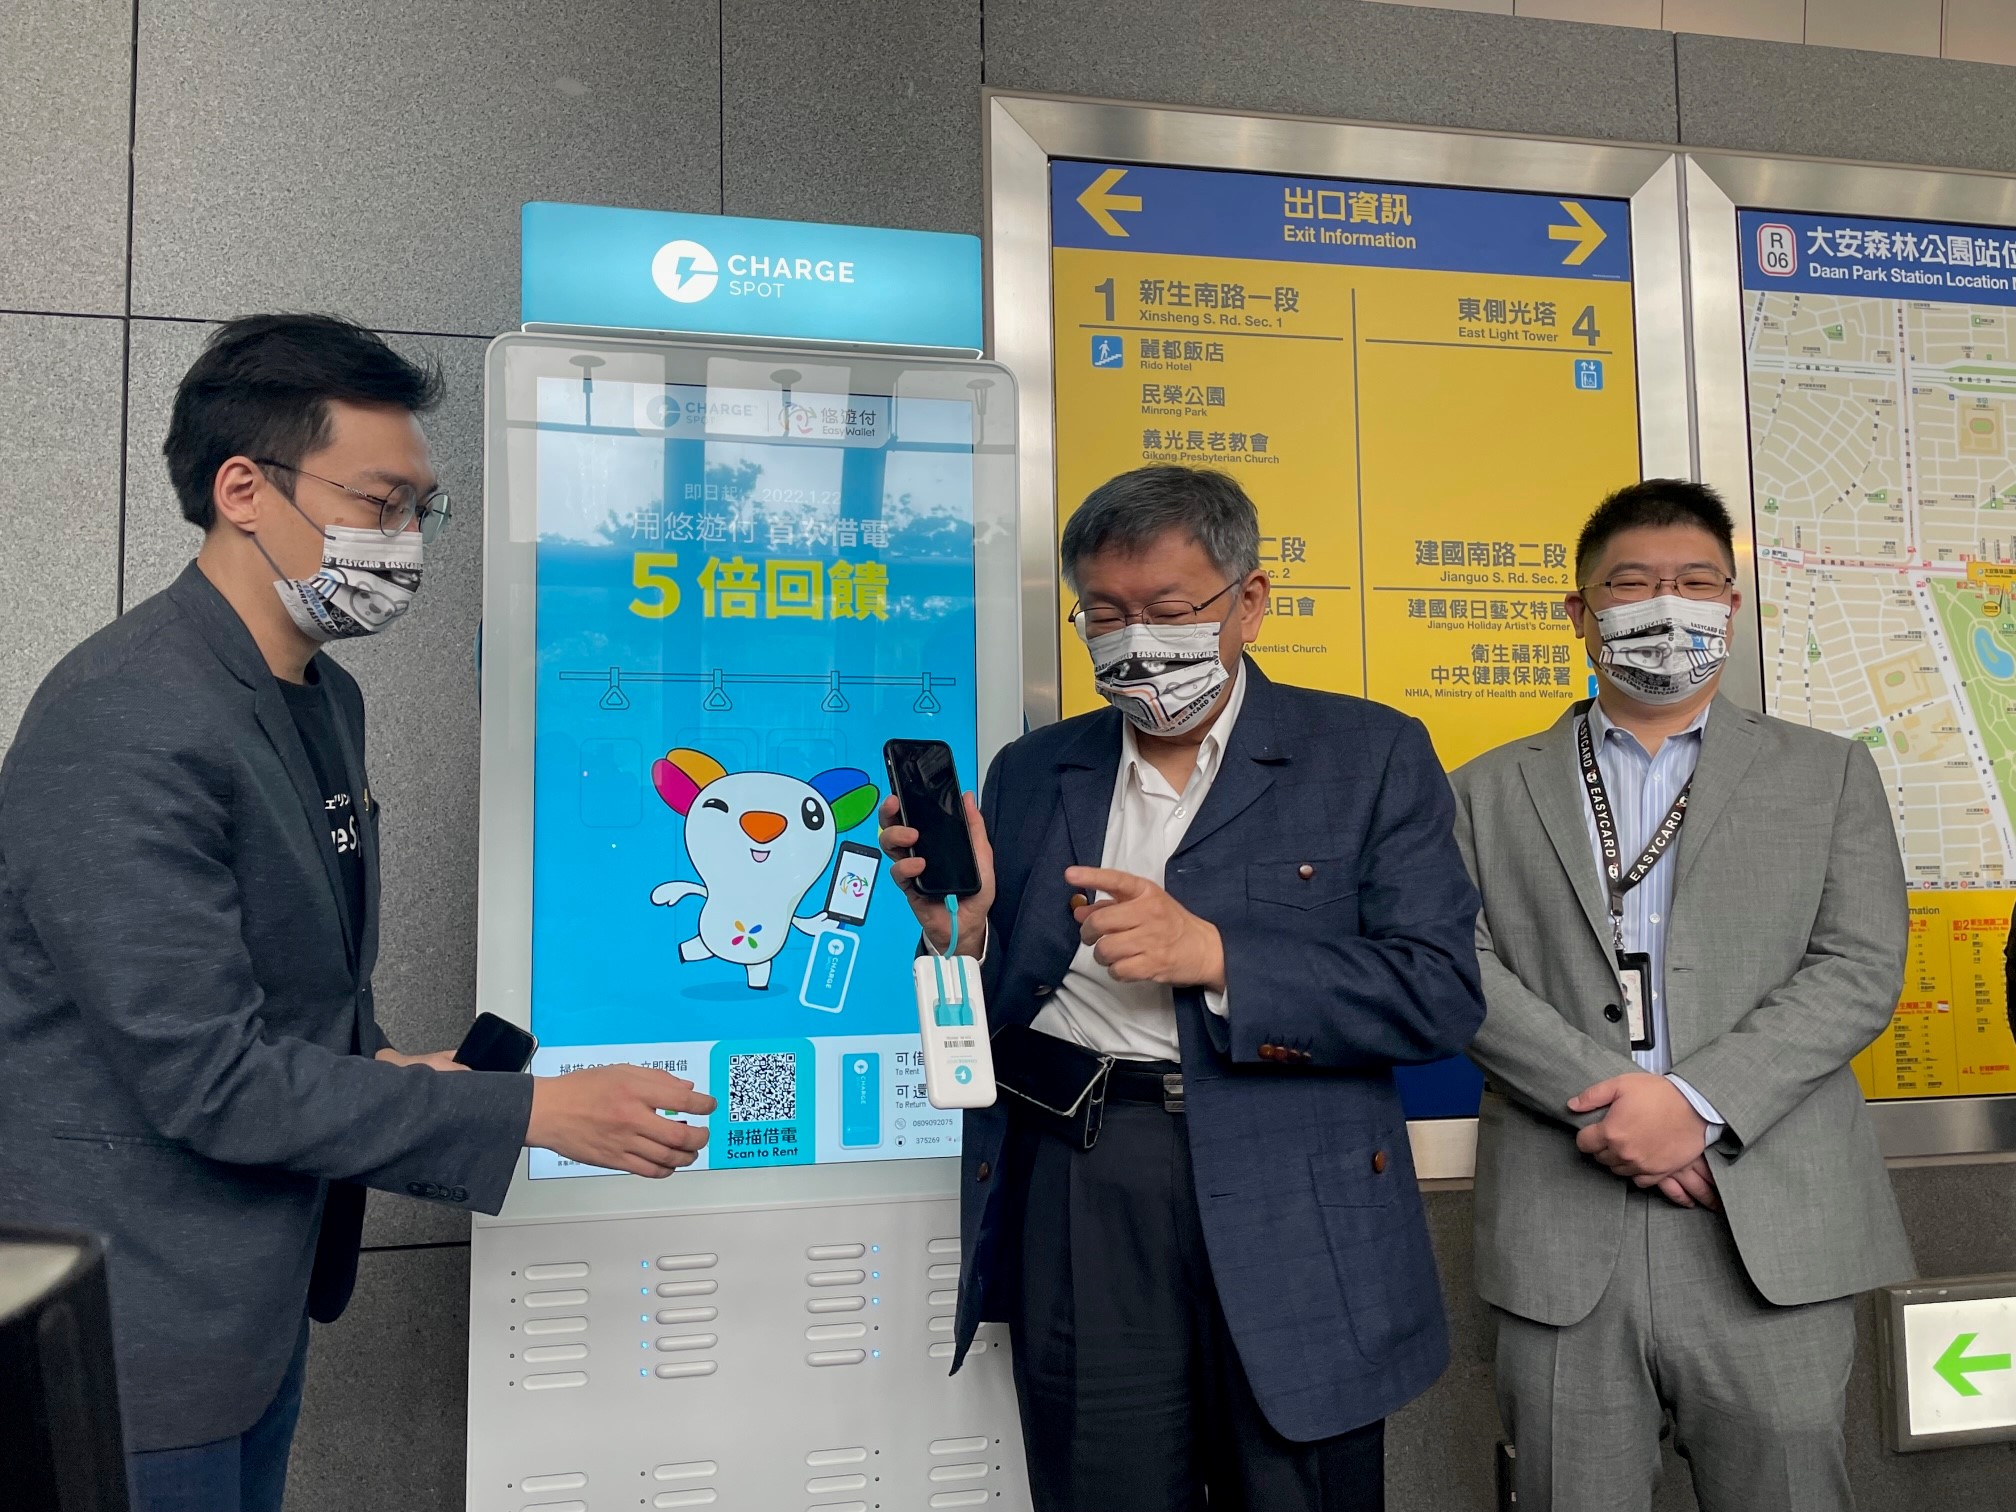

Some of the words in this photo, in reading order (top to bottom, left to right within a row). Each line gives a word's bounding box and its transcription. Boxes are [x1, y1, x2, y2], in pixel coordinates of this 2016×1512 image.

[1284, 186, 1412, 226] 出口資訊
[1283, 224, 1316, 243] Exit
[1320, 227, 1417, 250] Information
[1770, 232, 1784, 249] R
[727, 254, 856, 283] CHARGE
[1767, 251, 1789, 269] 06
[1809, 262, 1849, 280] Daan
[1852, 265, 1888, 282] Park
[1890, 268, 1943, 286] Station
[1946, 271, 2009, 290] Location
[729, 280, 785, 298] SPOT
[1139, 278, 1299, 313] 新生南路一段
[1094, 278, 1115, 322] 1
[1139, 309, 1200, 326] Xinsheng
[1203, 312, 1216, 325] S.
[1220, 313, 1241, 327] Rd.
[1245, 315, 1272, 328] Sec.
[1276, 316, 1283, 328] 1
[1458, 297, 1557, 328] 東側光塔
[1458, 327, 1486, 339] East
[1489, 328, 1519, 342] Light
[1522, 330, 1559, 343] Tower
[1571, 305, 1601, 346] 4
[1140, 338, 1225, 362] 麗都飯店
[1140, 360, 1164, 371] Rido
[1166, 361, 1193, 371] Hotel
[1141, 383, 1226, 407] 民榮公園
[685, 401, 752, 417] CHARGE
[821, 407, 877, 426] 悠遊付
[1141, 405, 1182, 417] Minrong
[1184, 407, 1208, 417] Park
[822, 425, 876, 437] EasyWallet
[1142, 428, 1269, 453] 義光長老教會
[1142, 450, 1178, 463] Gikong
[1180, 451, 1242, 464] Presbyterian
[1244, 454, 1280, 464] Church
[631, 512, 757, 544] 用悠遊付
[768, 518, 889, 549] 首次借電
[1258, 536, 1306, 563] 二段
[1414, 538, 1567, 569] 建國南路二段
[335, 557, 381, 569] EASYCARD
[1282, 567, 1291, 579] 2
[628, 551, 681, 619] 5
[697, 555, 890, 622] 倍回饋
[1440, 571, 1489, 585] Jianguo
[1492, 572, 1504, 583] S.
[1508, 572, 1528, 584] Rd.
[1531, 573, 1559, 585] Sec.
[1562, 573, 1569, 585] 2
[1407, 598, 1569, 620] 建國假日藝文特區
[1427, 620, 1465, 631] Jianguo
[1467, 620, 1502, 631] Holiday
[1504, 621, 1537, 631] Artist's
[1539, 622, 1571, 631] Corner
[1136, 651, 1176, 659] EASYCARD
[1244, 643, 1290, 653] Adventist
[1291, 643, 1327, 653] Church
[1471, 643, 1571, 664] 衛生福利部
[1431, 665, 1571, 686] 中央健康保險署
[1405, 688, 1433, 699] NHIA,
[1434, 688, 1473, 699] Ministry
[1475, 688, 1484, 698] of
[1486, 689, 1517, 698] Health
[1519, 689, 1537, 698] and
[1539, 689, 1574, 699] Welfare
[1590, 786, 1616, 858] EASYCARD
[1629, 811, 1682, 882] EASYCARD
[727, 1127, 798, 1147] 掃描借電
[726, 1148, 755, 1160] Scan
[757, 1148, 769, 1158] to
[772, 1147, 799, 1157] Rent
